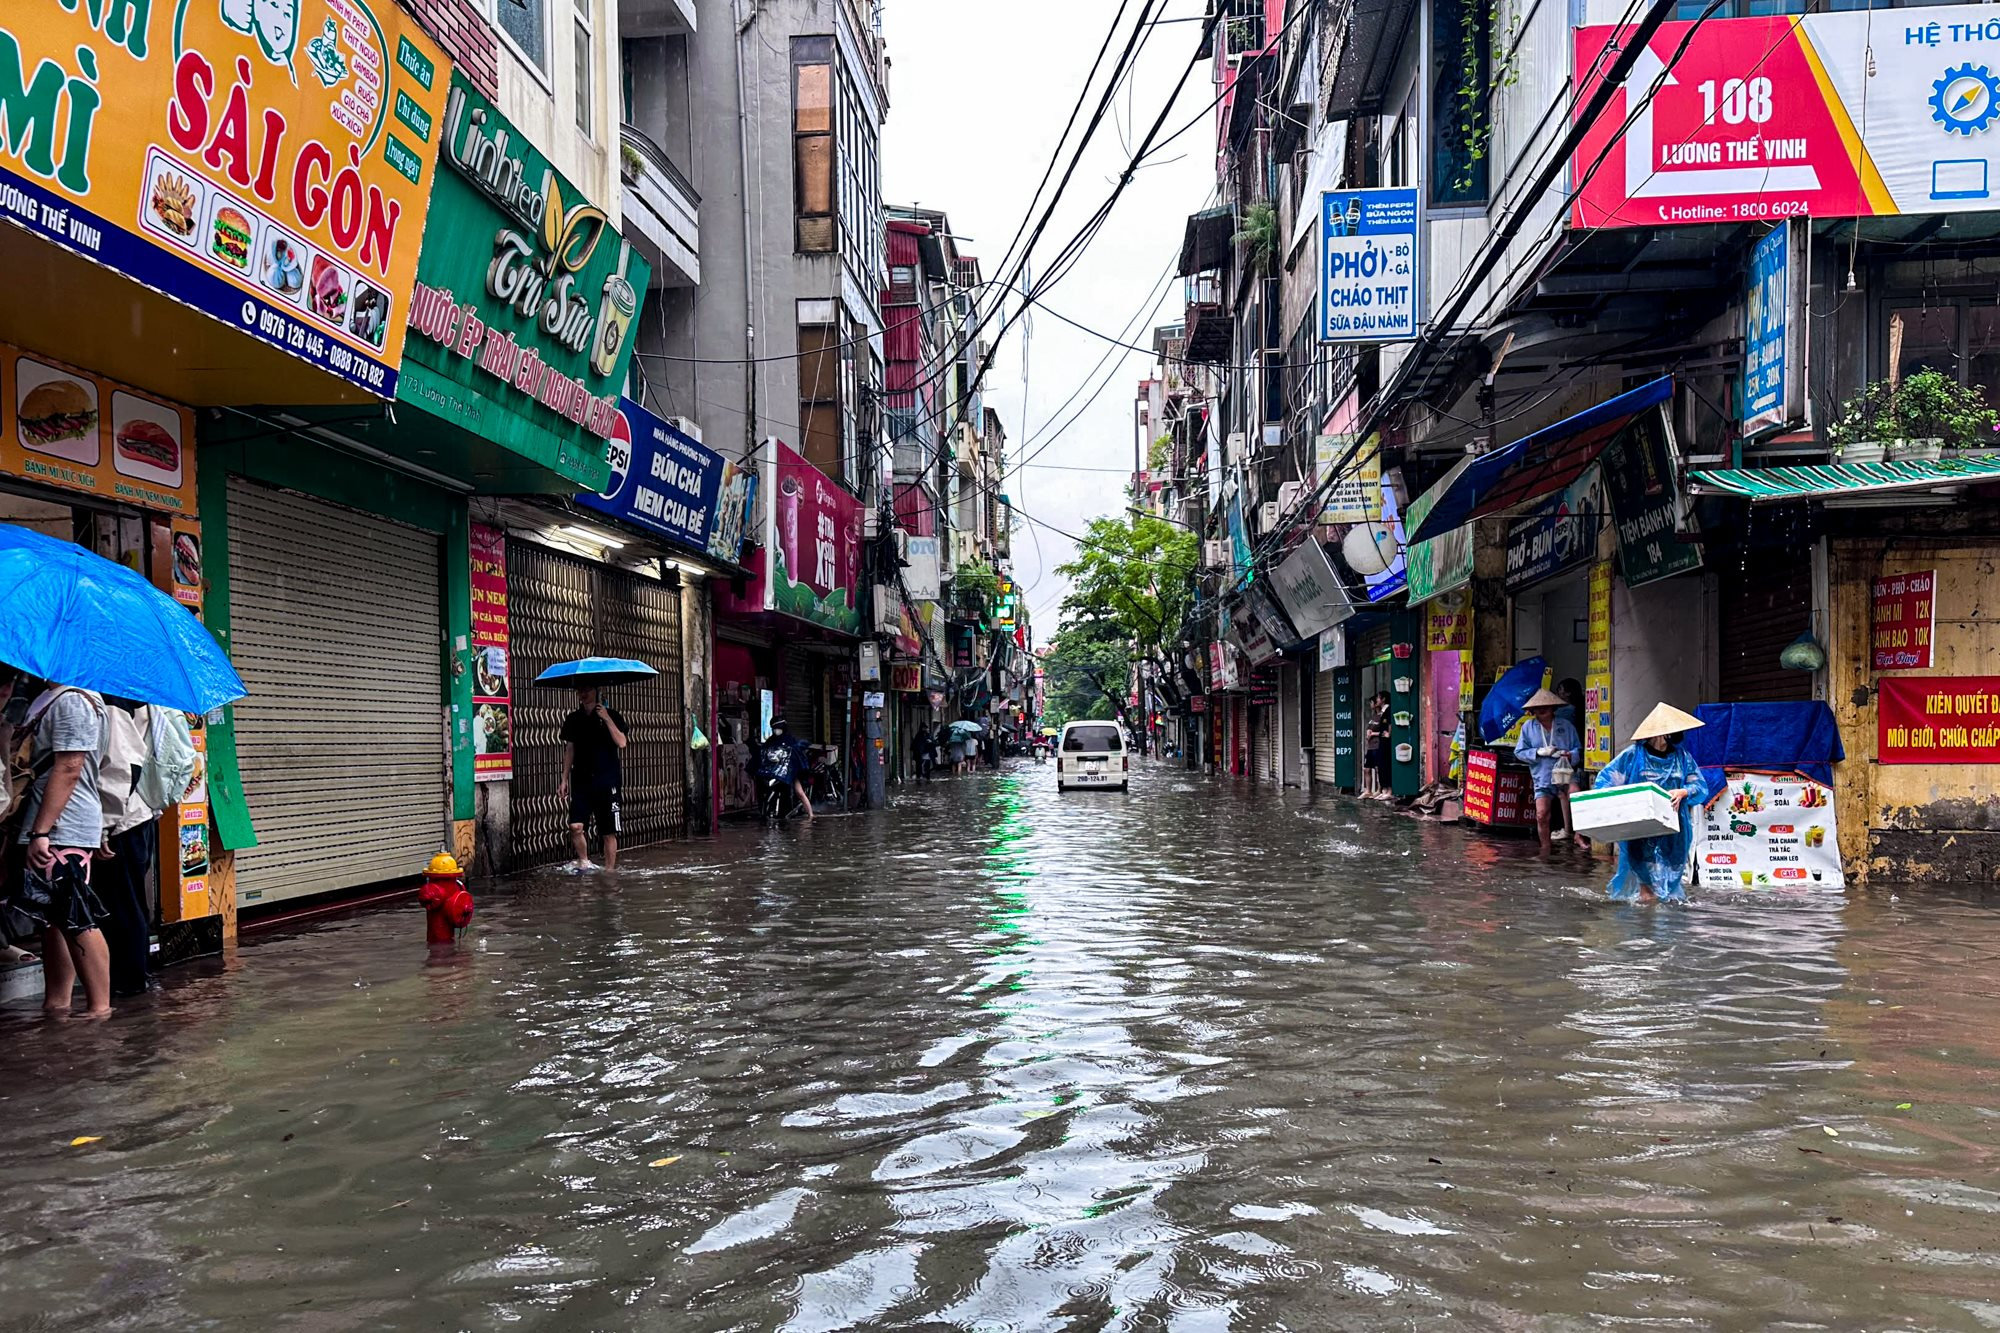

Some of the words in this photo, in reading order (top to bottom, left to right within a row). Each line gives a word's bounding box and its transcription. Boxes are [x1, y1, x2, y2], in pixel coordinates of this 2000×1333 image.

[352, 16, 368, 37] PATE
[1905, 24, 1940, 48] HỆ
[354, 59, 378, 86] JAMBON
[400, 41, 419, 76] Thức
[420, 63, 430, 87] ăn
[358, 85, 375, 107] RUỐC
[1698, 76, 1772, 125] 108
[332, 105, 347, 123] XÚC
[347, 112, 362, 135] XÍCH
[411, 109, 429, 139] dùng
[386, 136, 405, 171] Trong
[405, 157, 420, 181] ngày
[1663, 141, 1721, 165] LƯƠNG
[1726, 134, 1759, 162] THẾ
[1765, 138, 1807, 160] VINH
[169, 51, 286, 202] SÀI
[293, 142, 401, 276] GÒN
[1387, 209, 1414, 217] NGON
[1671, 205, 1727, 219] Hotline:
[1732, 203, 1767, 217] 1800
[1772, 202, 1808, 216] 6024
[41, 204, 69, 235] THẾ
[70, 218, 101, 251] VINH
[1330, 240, 1378, 279] PHỞ
[1395, 243, 1409, 257] BÒ
[488, 230, 547, 318] Trà
[1396, 261, 1410, 275] GÀ
[1331, 283, 1372, 307] CHÁO
[1376, 286, 1408, 309] THỊT
[1330, 314, 1350, 330] SỮA
[1354, 313, 1375, 332] ĐẬU
[1378, 311, 1408, 329] NÀNH
[259, 309, 285, 340] 0976
[287, 323, 305, 349] 126
[306, 332, 324, 358] 445
[330, 345, 352, 372] 0888
[352, 355, 367, 380] 779
[368, 364, 384, 388] 882
[409, 281, 460, 347] NƯỚC
[458, 306, 485, 360] ÉP
[481, 329, 519, 384] TRÁI
[515, 346, 546, 403] CÂY
[541, 365, 591, 426] NGUYÊN
[588, 394, 618, 440] CHẤT
[1766, 364, 1781, 389] 30K
[403, 374, 418, 393] 173
[464, 402, 482, 423] Vinh
[24, 457, 47, 475] BÁNH
[650, 451, 677, 486] BÚN
[677, 469, 702, 498] CHẢ
[634, 485, 664, 518] NEM
[663, 498, 687, 529] CUA
[688, 506, 707, 535] BỂ
[1620, 517, 1641, 545] TIỆM
[1639, 508, 1663, 538] BÁNH
[1507, 533, 1526, 573] PHỞ
[1532, 525, 1553, 561] BÚN
[1647, 541, 1662, 565] 184
[471, 583, 484, 601] ÚN
[486, 591, 506, 606] NEM
[1891, 577, 1905, 595] PHỞ
[1910, 577, 1930, 593] CHÁO
[1893, 598, 1902, 621] MÌ
[1915, 600, 1929, 619] 12K
[480, 630, 493, 641] CUA
[1891, 629, 1908, 648] BAO
[1914, 627, 1928, 646] 10K
[1926, 690, 1952, 714] KIÊN
[1955, 688, 1988, 716] QUYẾT
[1887, 723, 1908, 748] MÔI
[1911, 723, 1937, 750] GIỚI,
[1939, 723, 1969, 748] CHỨA
[1971, 721, 2000, 748] CHẤP
[1501, 775, 1518, 788] PHỞ
[1499, 791, 1517, 803] BÚN
[1498, 806, 1515, 818] BÚN
